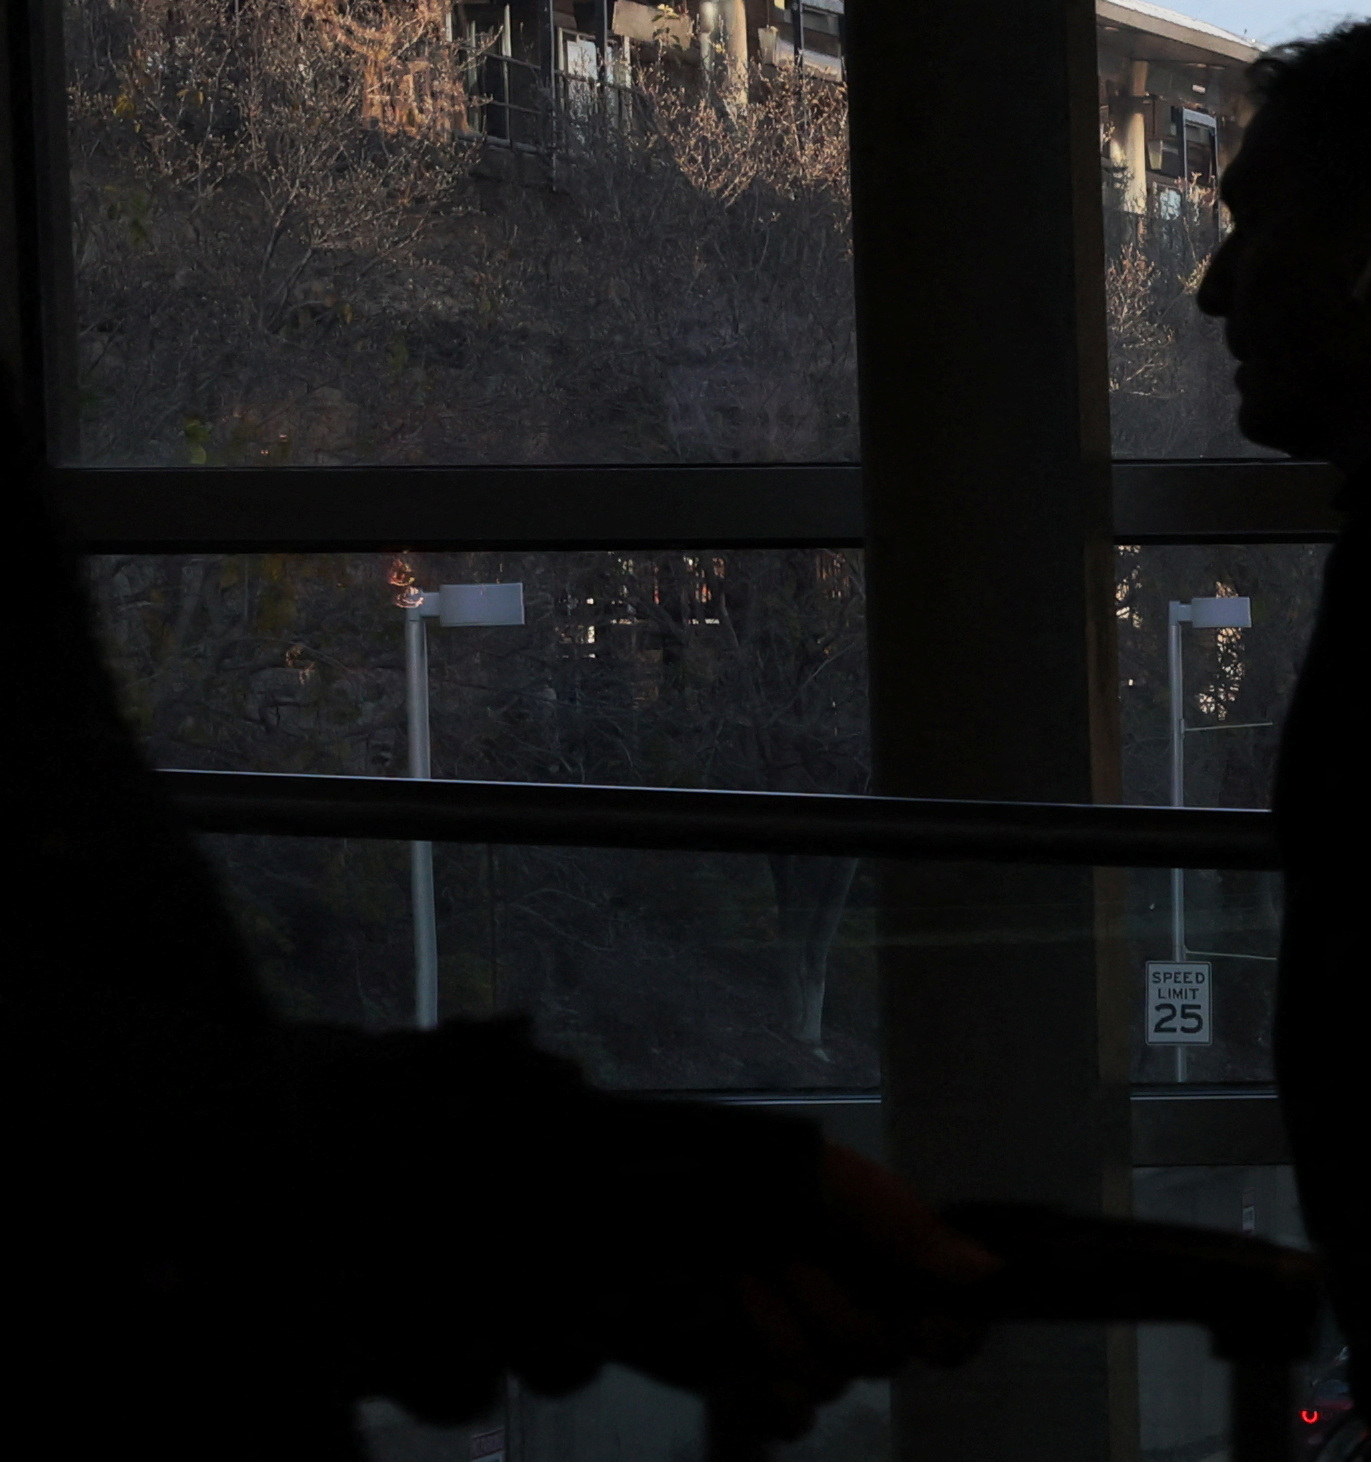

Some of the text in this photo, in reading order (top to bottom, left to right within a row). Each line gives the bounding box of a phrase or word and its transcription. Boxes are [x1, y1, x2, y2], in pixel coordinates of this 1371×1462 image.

[1152, 971, 1205, 984] SPEED
[1158, 988, 1199, 999] LIMIT
[1154, 1003, 1204, 1034] 25
